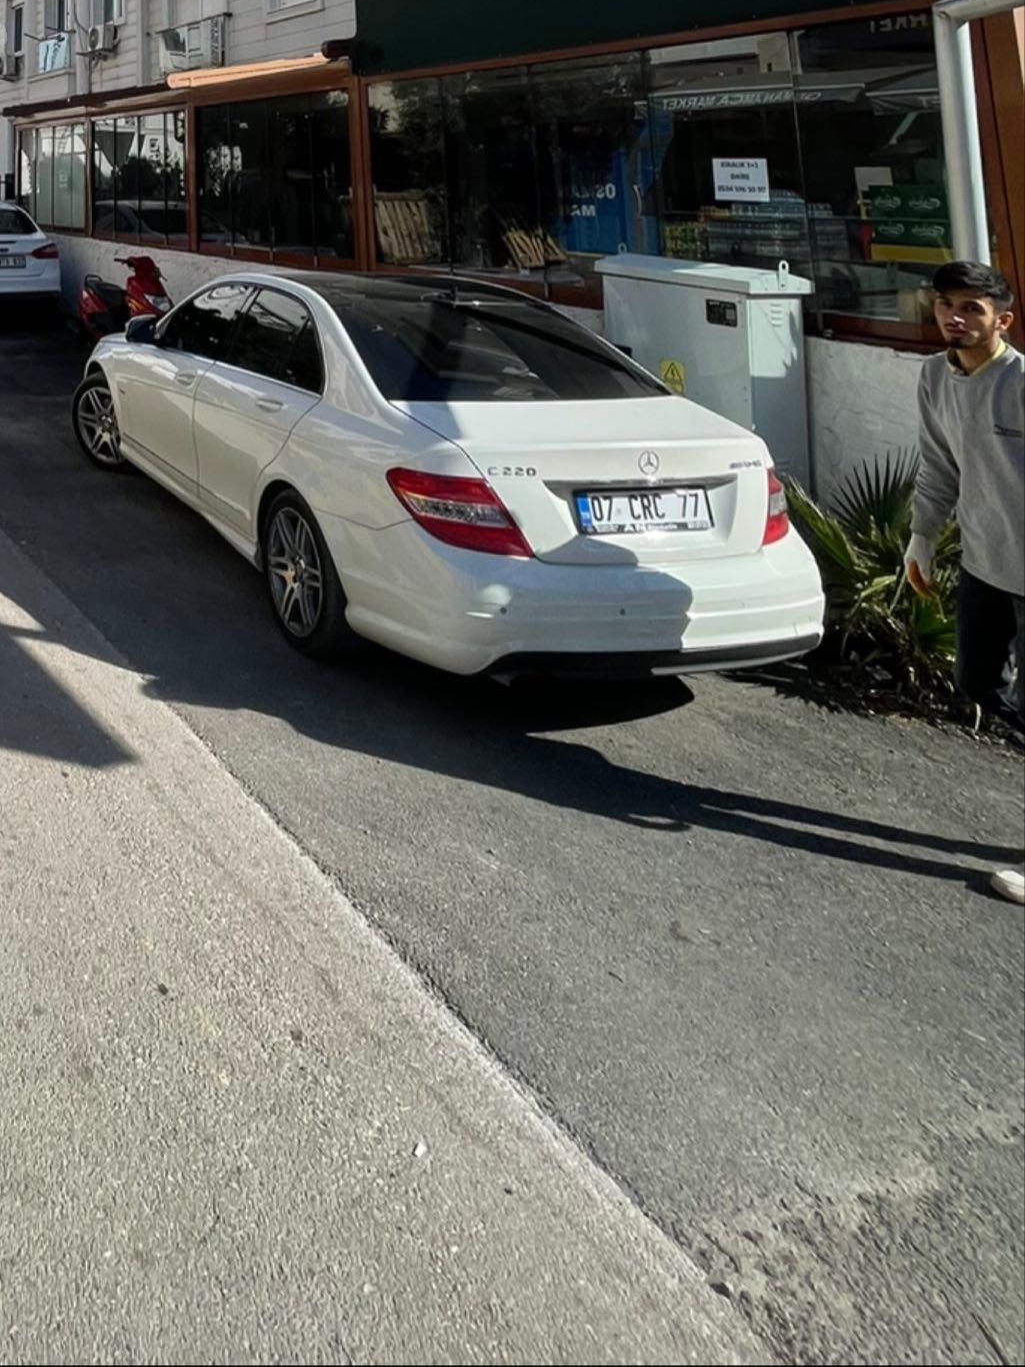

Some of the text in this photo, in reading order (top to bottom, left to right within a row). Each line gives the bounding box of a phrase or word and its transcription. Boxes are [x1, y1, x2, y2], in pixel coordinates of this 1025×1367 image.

[487, 466, 537, 476] C 220
[591, 492, 698, 522] 07 CRC 77
